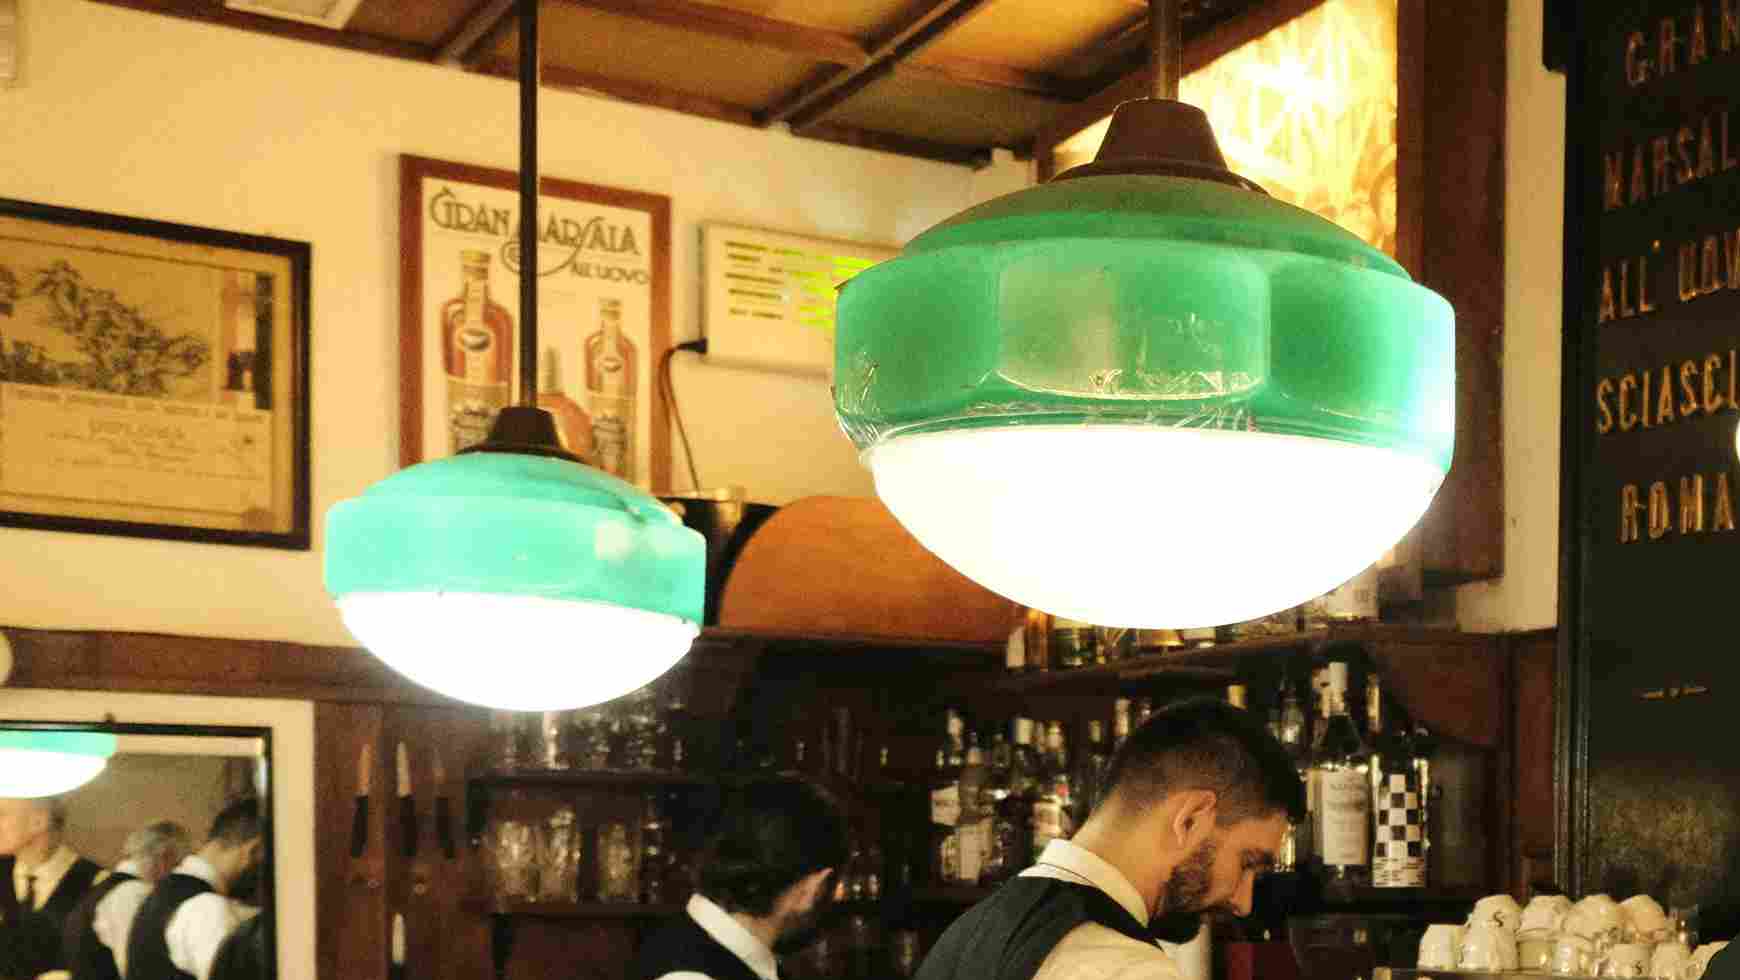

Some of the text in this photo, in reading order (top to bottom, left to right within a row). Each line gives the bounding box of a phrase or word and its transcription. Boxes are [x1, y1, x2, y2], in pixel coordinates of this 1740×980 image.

[429, 186, 641, 256] GRAN ARSALA
[1617, 473, 1736, 544] ROMA
